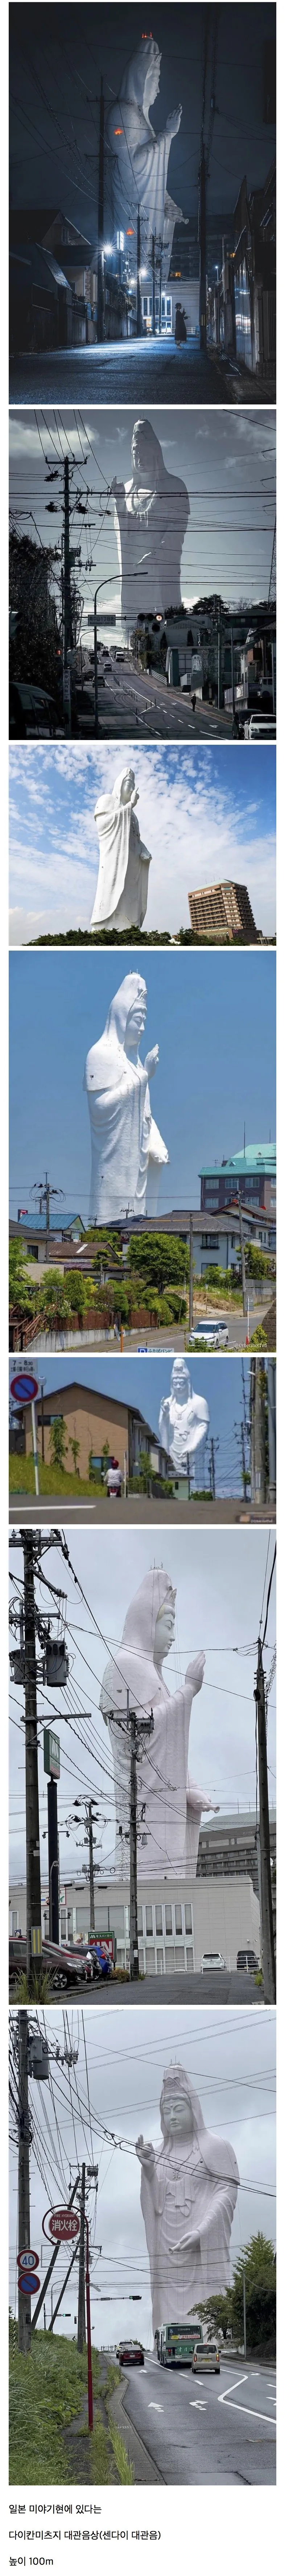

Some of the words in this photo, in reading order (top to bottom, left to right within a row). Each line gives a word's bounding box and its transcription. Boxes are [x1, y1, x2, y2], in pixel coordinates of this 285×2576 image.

[52, 2219, 78, 2231] 消火栓
[22, 2256, 34, 2265] 40
